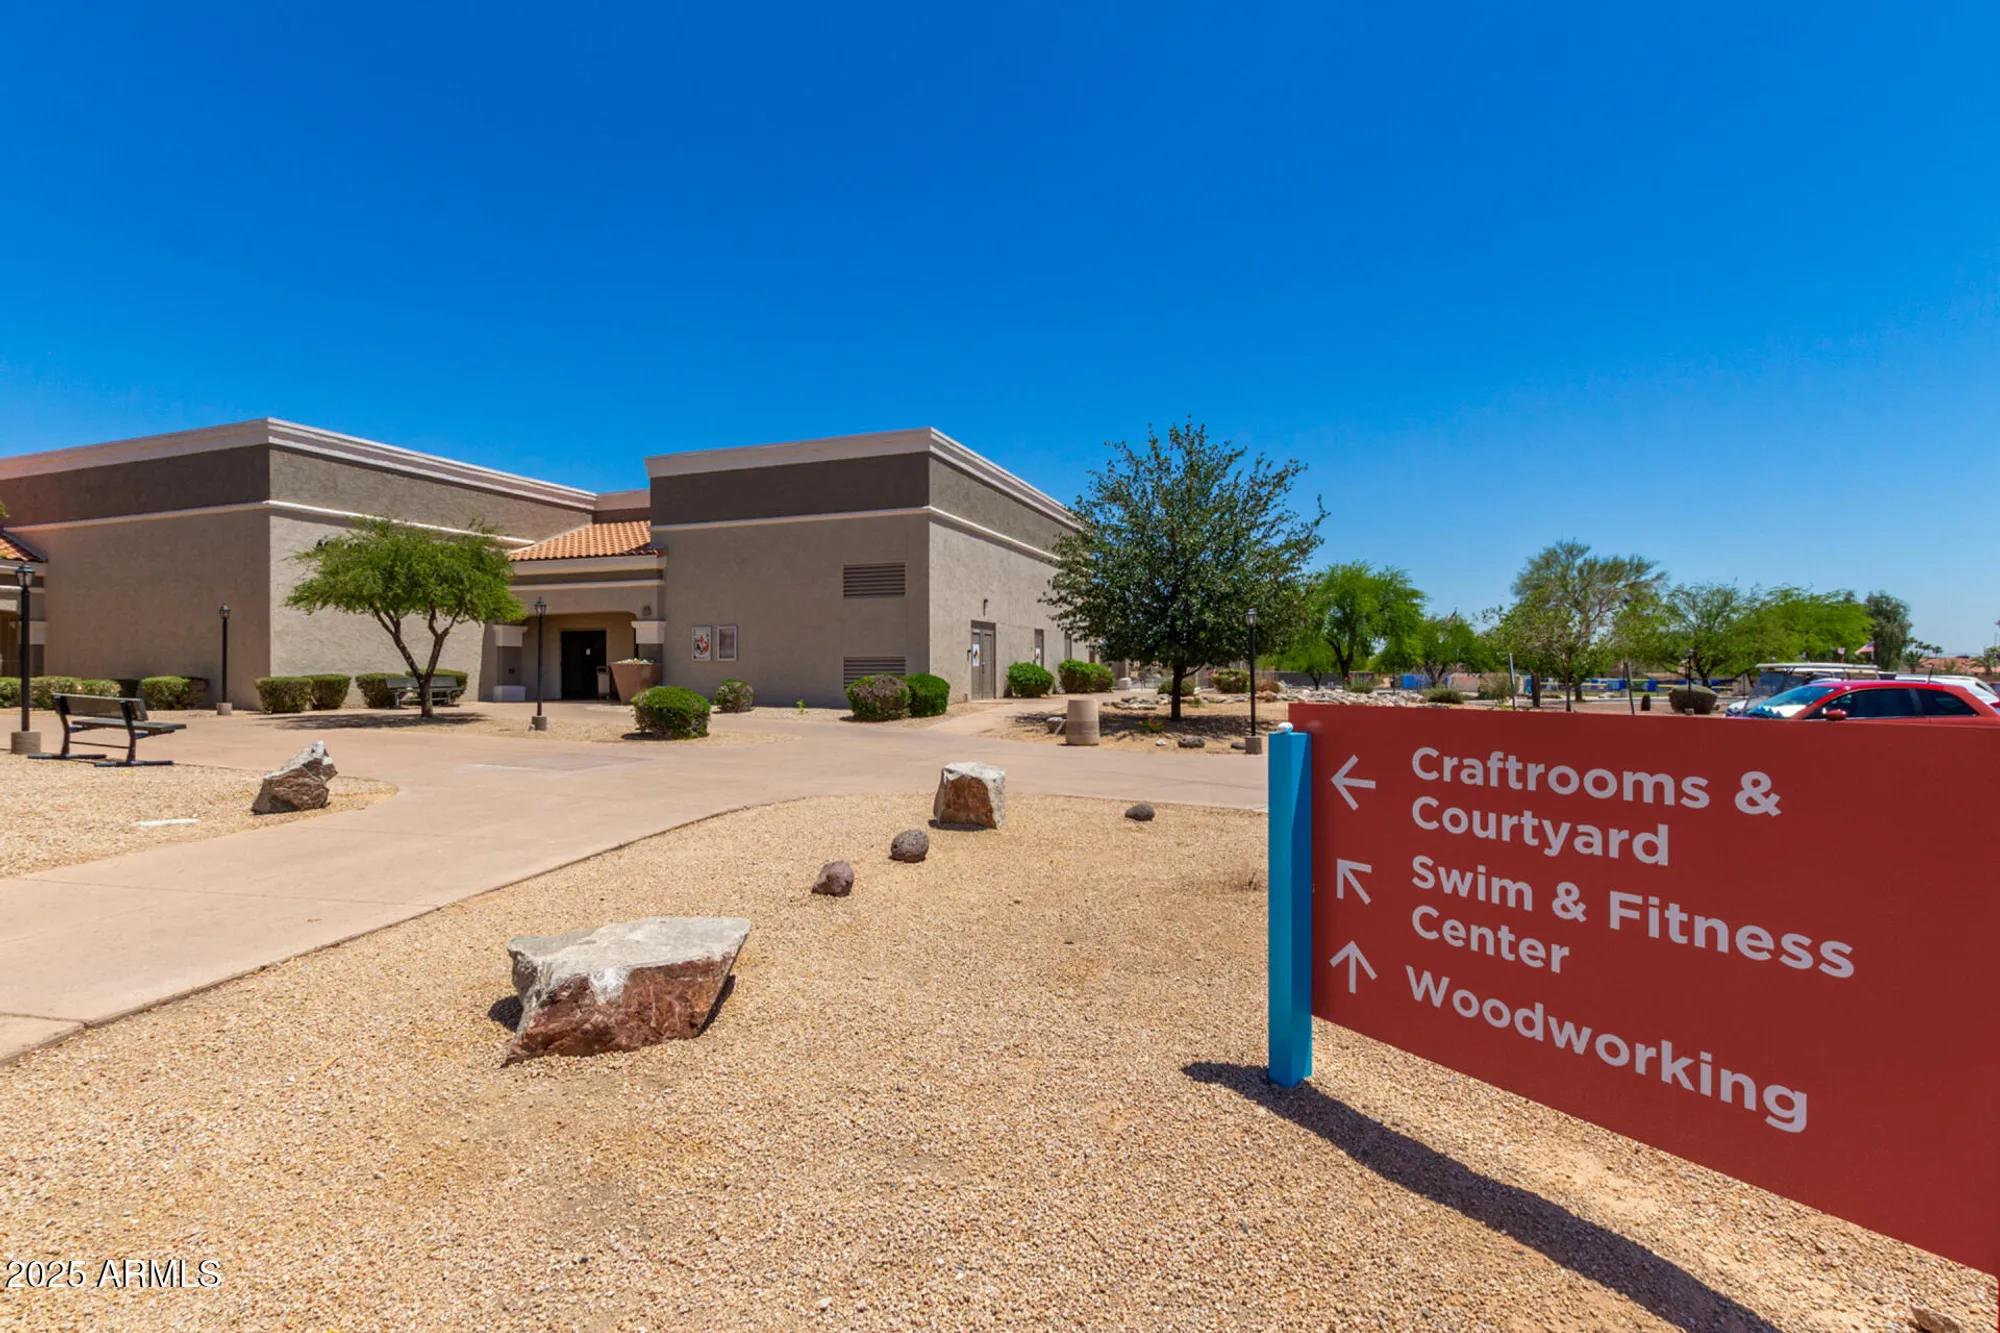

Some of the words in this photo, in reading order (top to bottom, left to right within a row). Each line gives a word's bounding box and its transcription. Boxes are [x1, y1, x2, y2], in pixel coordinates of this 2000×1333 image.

[1411, 746, 1710, 809] Craftrooms
[1734, 770, 1782, 817] &
[1411, 795, 1670, 867] Courtyard
[1411, 854, 1533, 912] Swim
[1551, 881, 1587, 923] &
[1609, 890, 1855, 979] Fitness
[1411, 904, 1570, 974] Center
[1405, 964, 1808, 1133] Woodworking
